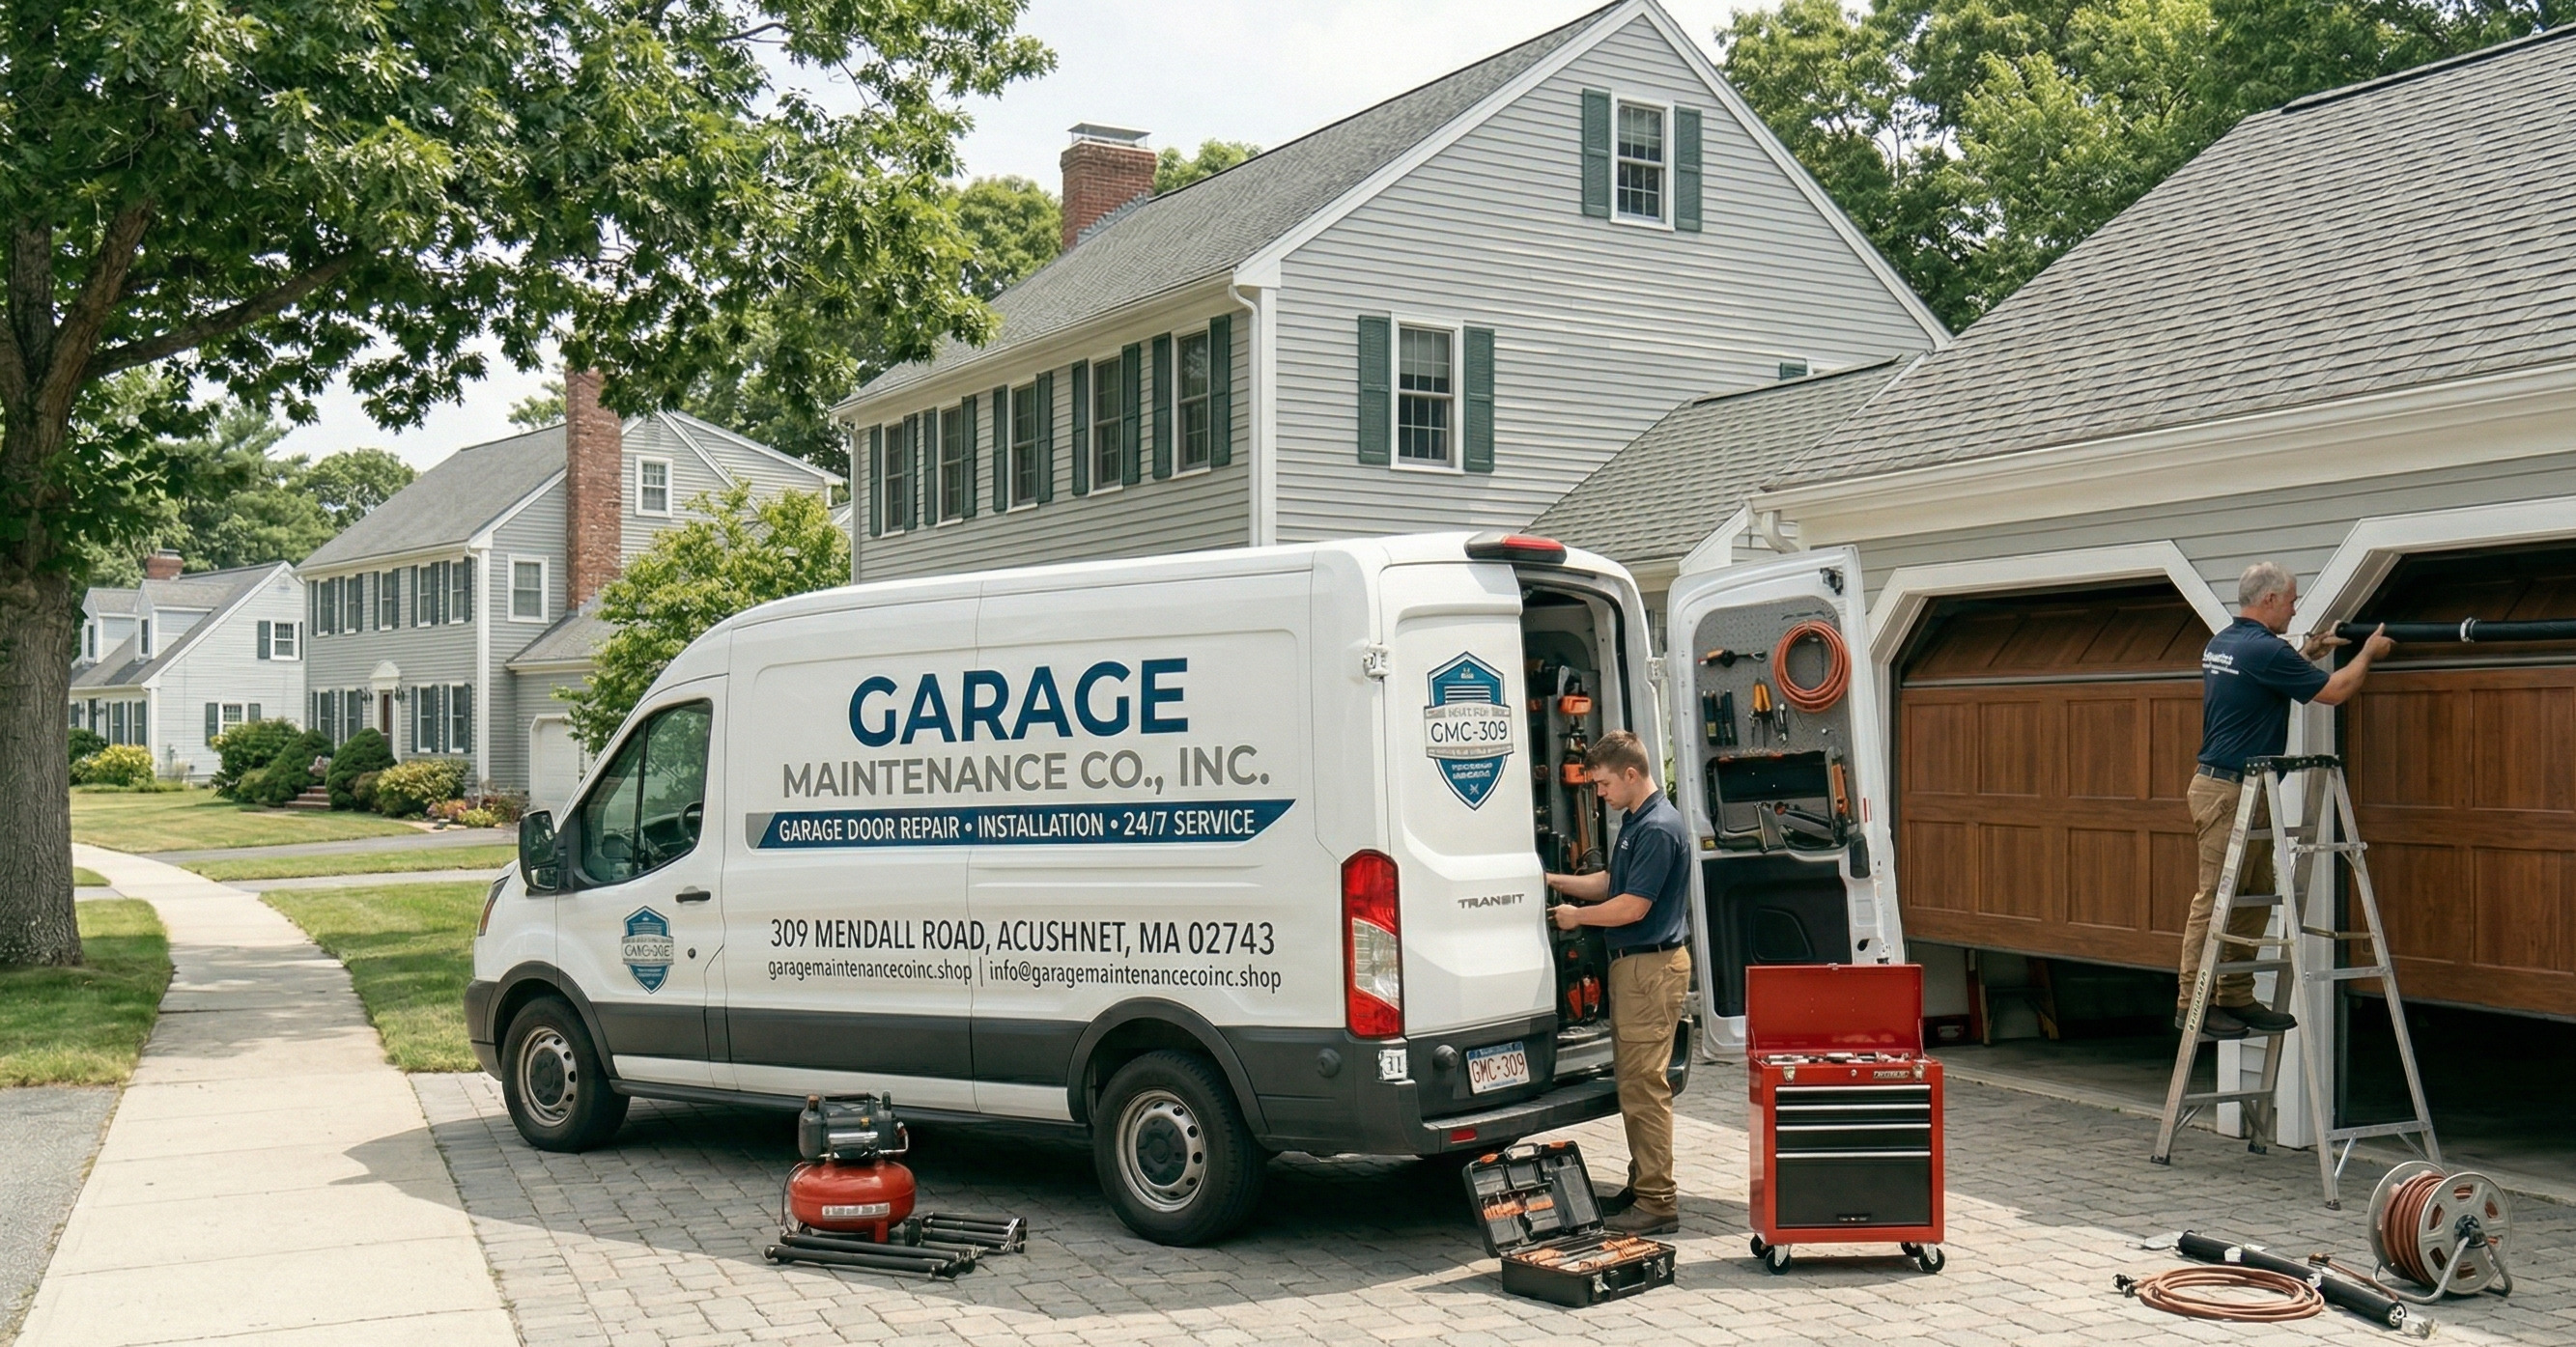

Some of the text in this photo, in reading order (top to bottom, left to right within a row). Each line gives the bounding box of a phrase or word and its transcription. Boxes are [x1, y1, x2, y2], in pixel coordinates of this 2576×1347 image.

[848, 658, 1188, 746] GARAGE
[1430, 720, 1507, 743] GMC-309
[783, 744, 1270, 799] MAINTENANCE CO., INC.
[778, 809, 1255, 842] GARAGE DOOR REPAIR INSTALLATION 24/7 SERVICE
[1458, 893, 1524, 909] TRANSIT
[771, 919, 1275, 958] 309 MENDALL ROAD, ACUSHNET, MA 02743
[769, 959, 1282, 994] garagemaintenancecoinc.shop info@garagemaintenancecoinc.shop
